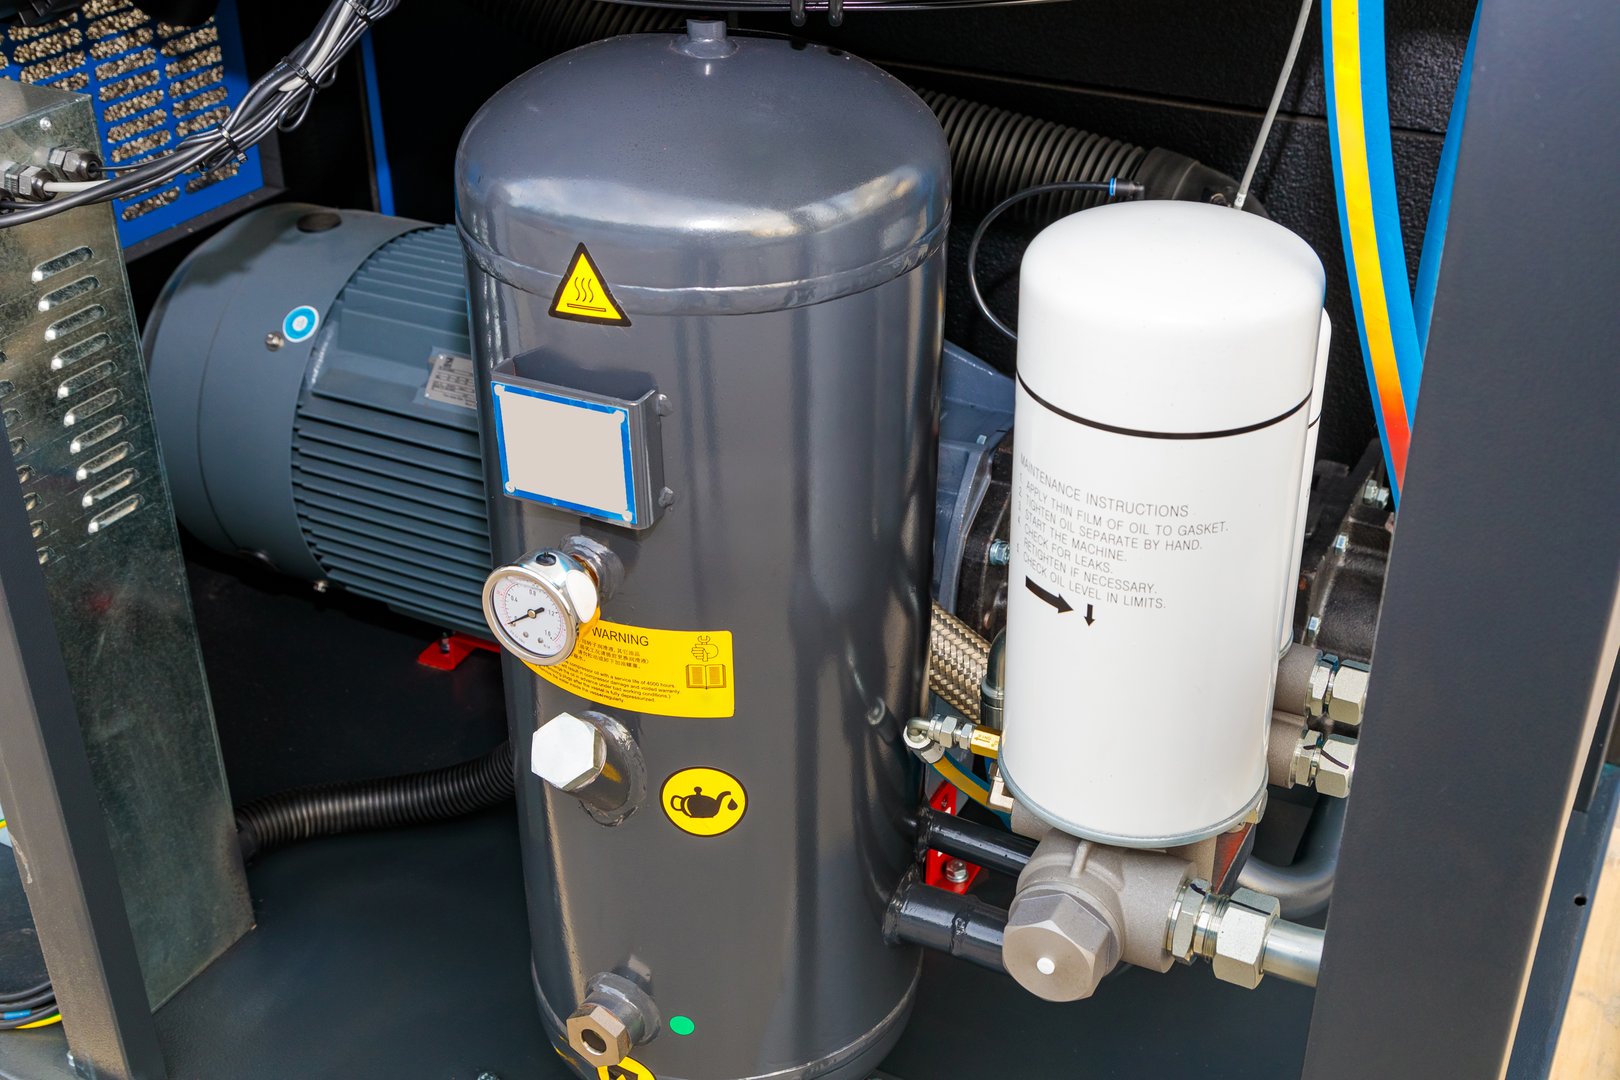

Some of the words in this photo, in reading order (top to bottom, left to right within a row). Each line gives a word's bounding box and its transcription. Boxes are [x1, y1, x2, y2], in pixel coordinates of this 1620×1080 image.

[1021, 453, 1081, 501] MAINTENANCE
[1086, 492, 1189, 518] INSTRUCTIONS
[1026, 481, 1048, 504] APPLY
[1051, 498, 1073, 517] THIN
[1077, 510, 1102, 527] FILM
[1107, 518, 1124, 531] OF
[1129, 522, 1149, 535] OIL
[1155, 524, 1172, 536] TO
[1178, 521, 1229, 536] GASKET.
[1024, 523, 1048, 549] CHECK
[1051, 543, 1071, 560] FOR
[1075, 554, 1113, 574] LEAKS.
[1025, 509, 1046, 532] START
[1050, 526, 1068, 545] THE
[1072, 537, 1127, 562] MACHINE.
[1026, 493, 1056, 524] TIGHTEN
[1060, 517, 1075, 534] OIL
[1079, 525, 1139, 549] SEPARATE
[1144, 539, 1160, 551] BY
[1165, 539, 1203, 551] HAND.
[1023, 551, 1047, 577] CHECK
[1050, 571, 1065, 588] OIL
[1069, 580, 1102, 601] LEVEL
[1107, 592, 1118, 604] IN
[1123, 595, 1166, 609] LIMITS.
[1024, 537, 1067, 573] RETIGHTEN
[1070, 567, 1079, 577] IF
[1084, 571, 1157, 594] NECESSARY.
[592, 626, 649, 647] WARNING
[584, 672, 609, 683] compressor
[610, 680, 630, 688] damage
[622, 689, 642, 697] working
